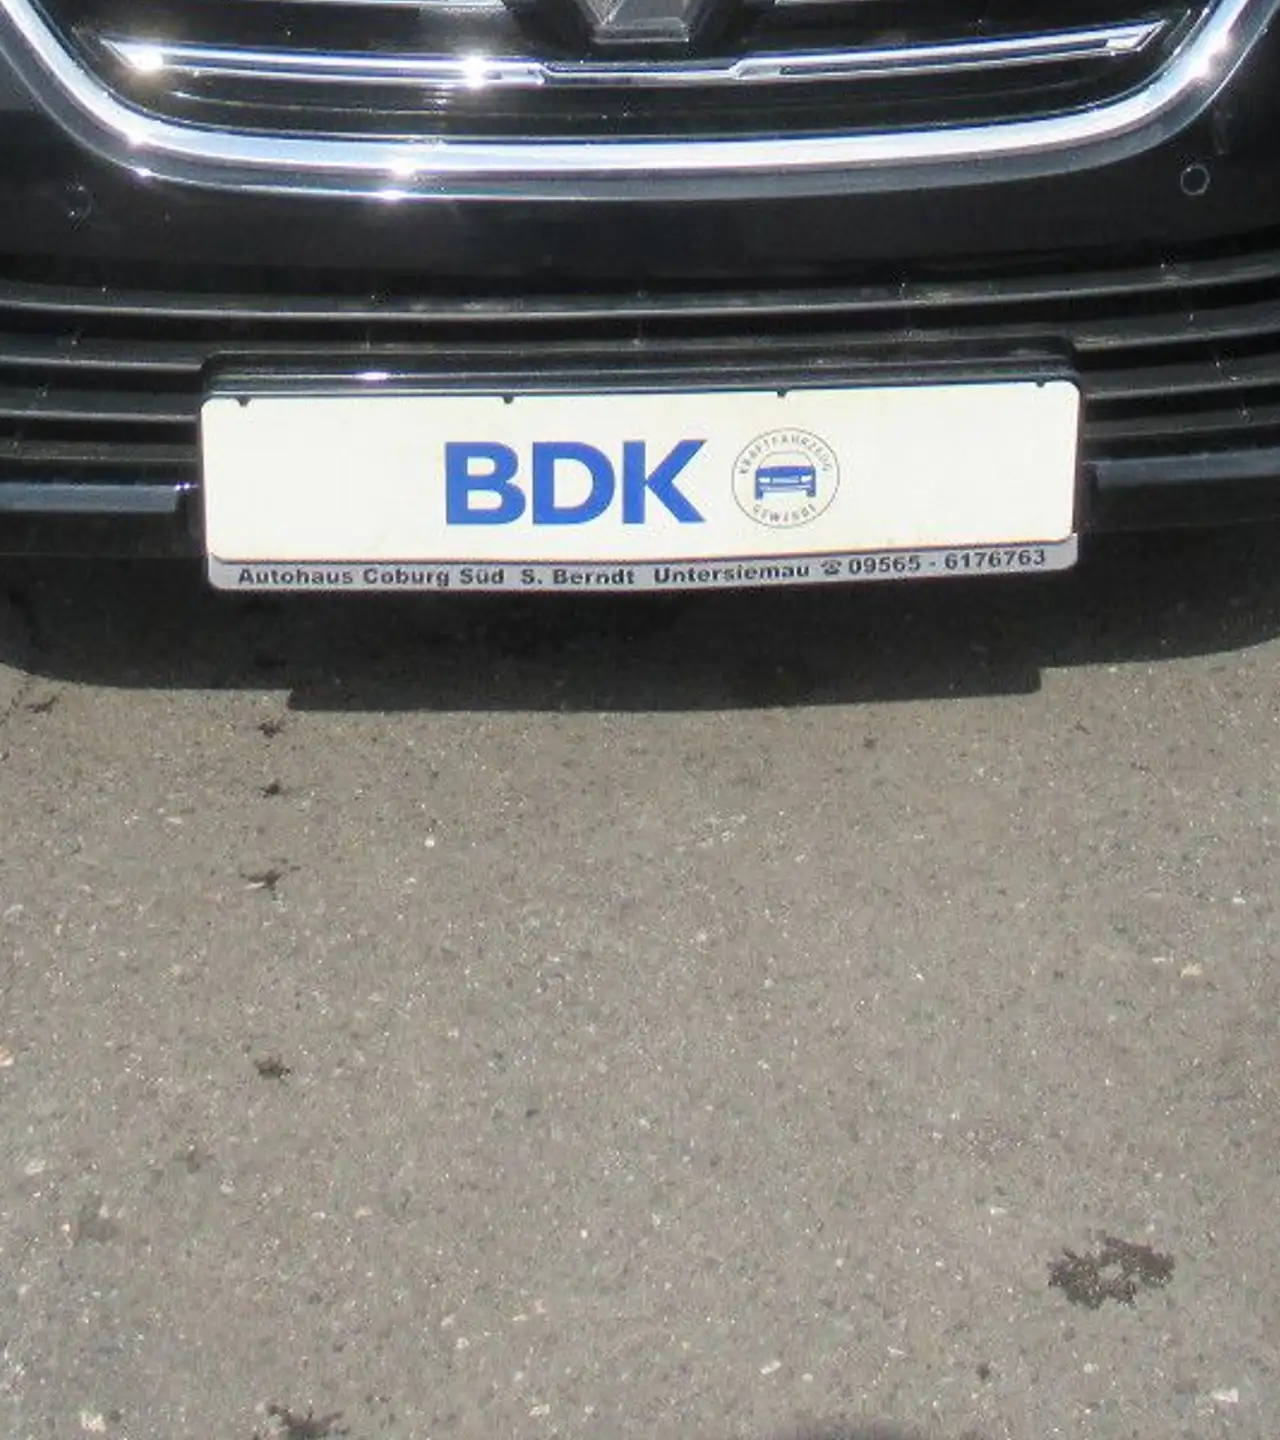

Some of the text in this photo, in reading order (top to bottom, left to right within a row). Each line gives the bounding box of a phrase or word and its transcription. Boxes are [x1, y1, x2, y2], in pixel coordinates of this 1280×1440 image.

[446, 439, 706, 525] BDK
[238, 567, 354, 585] Autohaus
[363, 567, 449, 587] Coburg
[459, 566, 505, 585] Süd
[521, 567, 543, 585] S.
[553, 567, 635, 585] Berndt
[654, 563, 810, 584] Untersiemau
[848, 554, 921, 574] 09565
[944, 548, 1046, 570] 6176763
